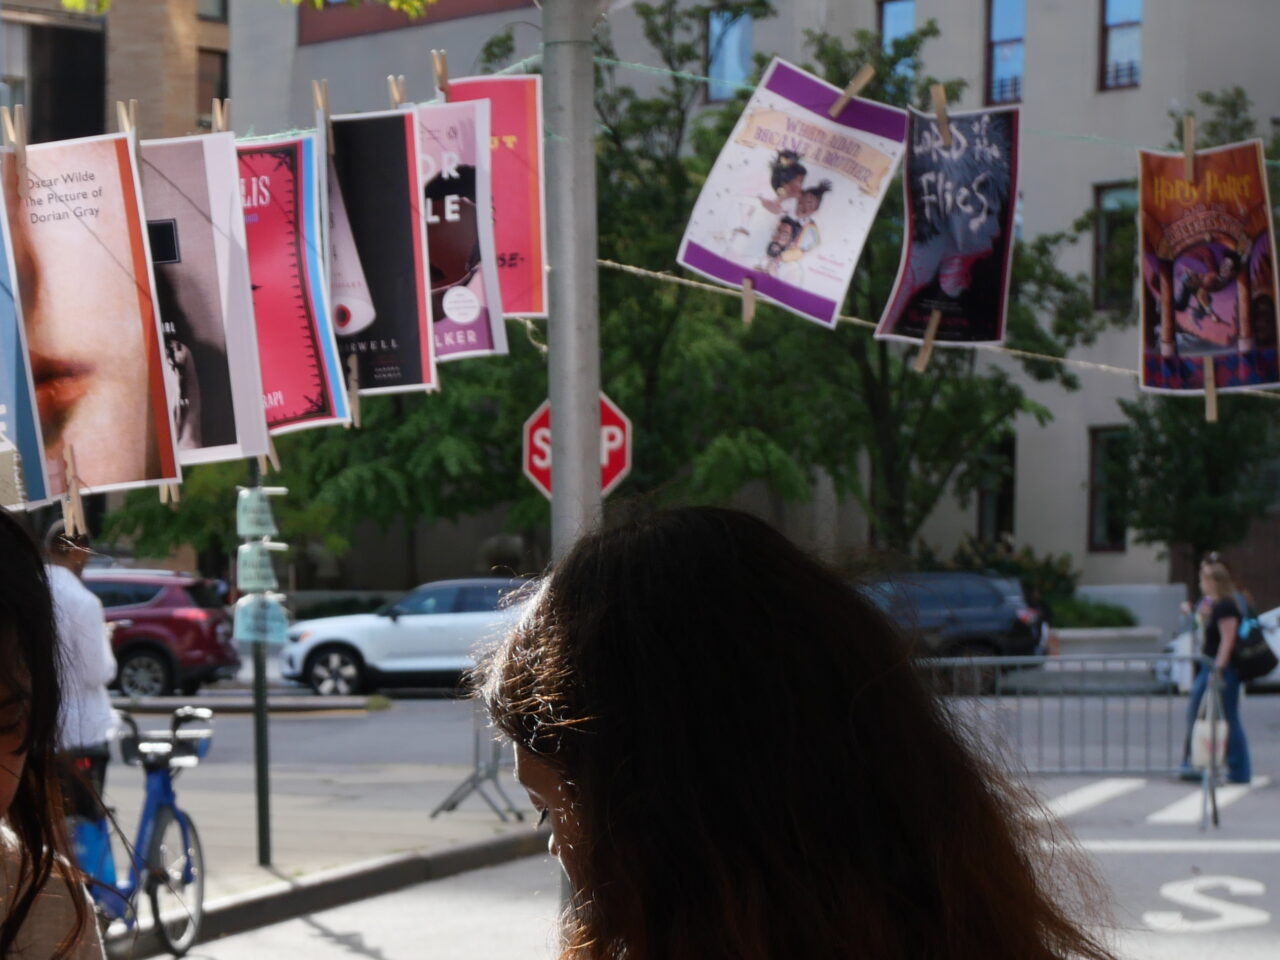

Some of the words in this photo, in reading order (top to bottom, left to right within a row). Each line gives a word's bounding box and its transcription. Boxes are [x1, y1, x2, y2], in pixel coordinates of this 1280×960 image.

[28, 178, 59, 190] Oscar
[62, 171, 96, 184] Wilde
[47, 190, 88, 204] Picture
[92, 186, 103, 198] of
[30, 209, 69, 224] Dorian
[73, 206, 100, 220] Gray
[531, 425, 625, 470] SP
